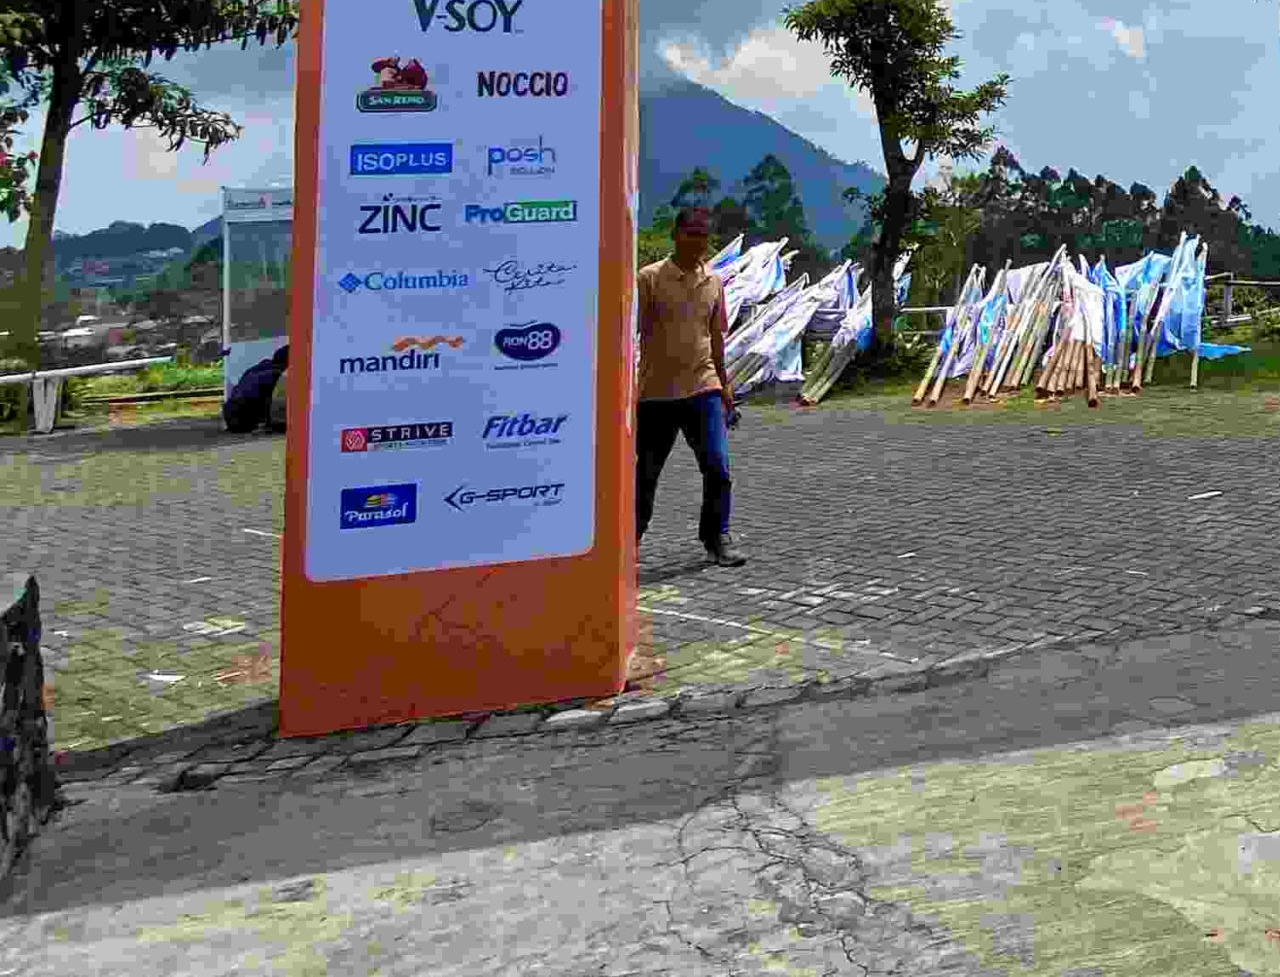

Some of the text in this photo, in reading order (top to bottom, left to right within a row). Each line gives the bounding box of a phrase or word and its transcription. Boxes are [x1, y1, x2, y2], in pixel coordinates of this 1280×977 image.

[476, 71, 568, 97] NOCCIO
[357, 151, 447, 171] ISOPLUS
[488, 135, 556, 176] posh
[358, 203, 442, 234] ZINC
[465, 201, 575, 223] ProGuard
[364, 270, 469, 291] Columbia
[339, 348, 441, 374] mandiri
[371, 423, 450, 442] STRIVE
[483, 414, 568, 439] Fitbar
[344, 502, 408, 522] Parasol
